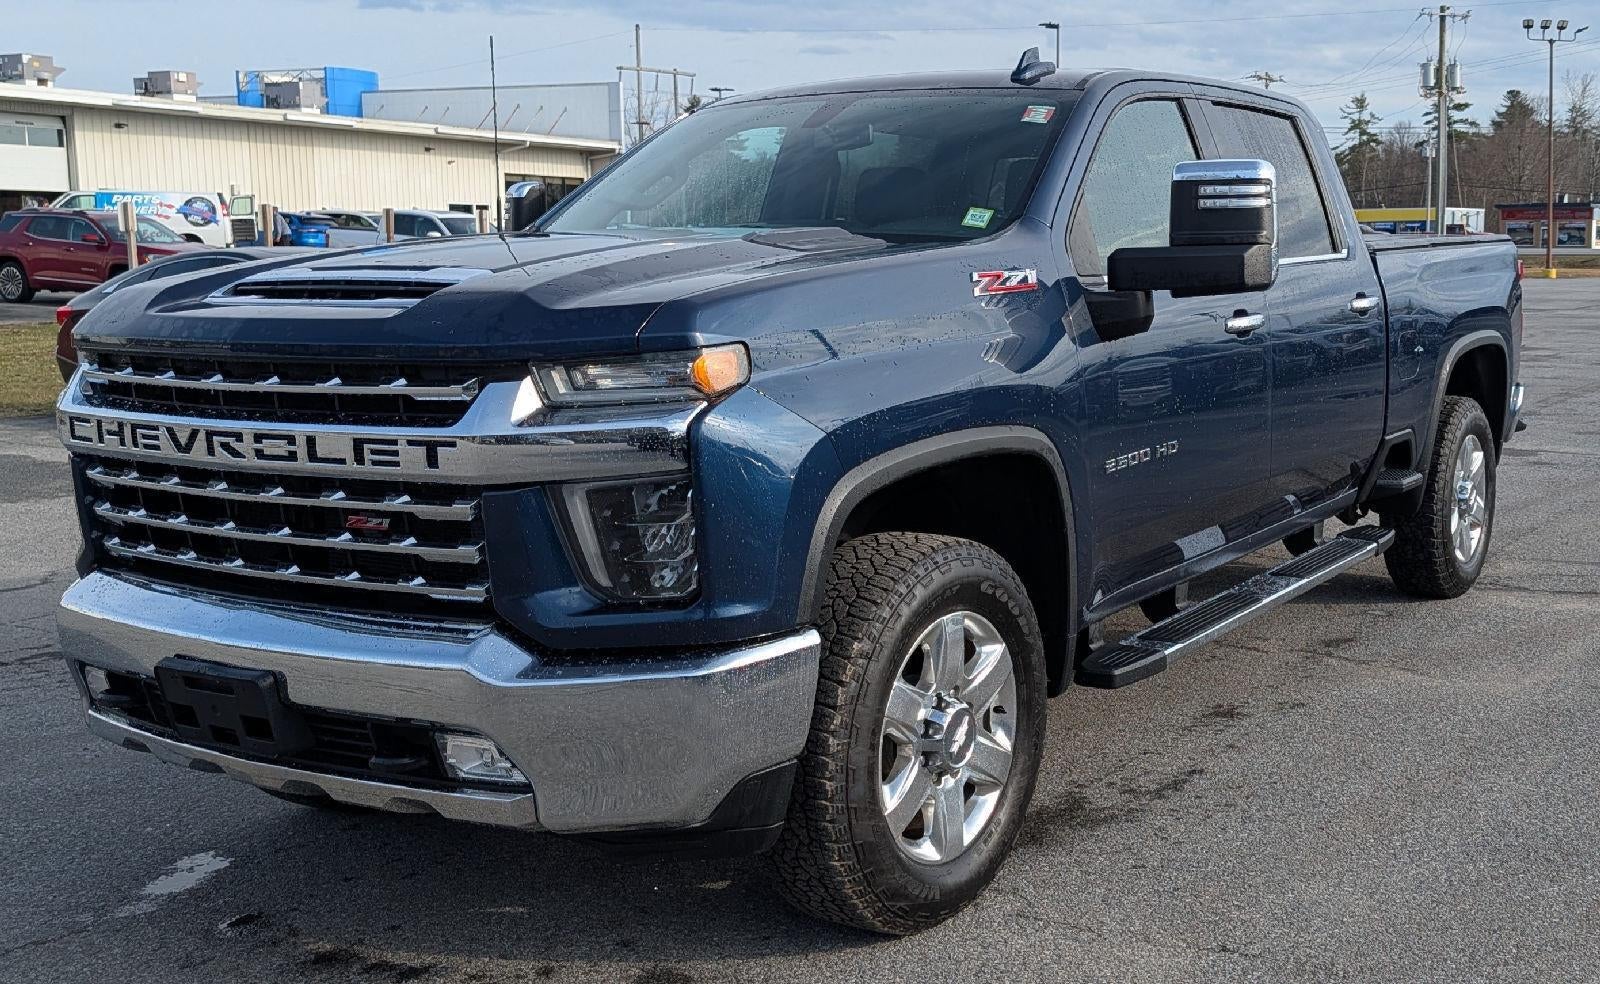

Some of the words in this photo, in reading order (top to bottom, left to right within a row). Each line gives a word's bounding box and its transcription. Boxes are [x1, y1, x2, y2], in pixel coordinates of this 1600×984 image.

[112, 194, 161, 204] PARTS
[970, 269, 1038, 297] Z71
[69, 416, 458, 471] CHEVROLET
[1105, 447, 1150, 474] 2500
[1155, 440, 1179, 458] HD
[345, 515, 391, 530] Z71
